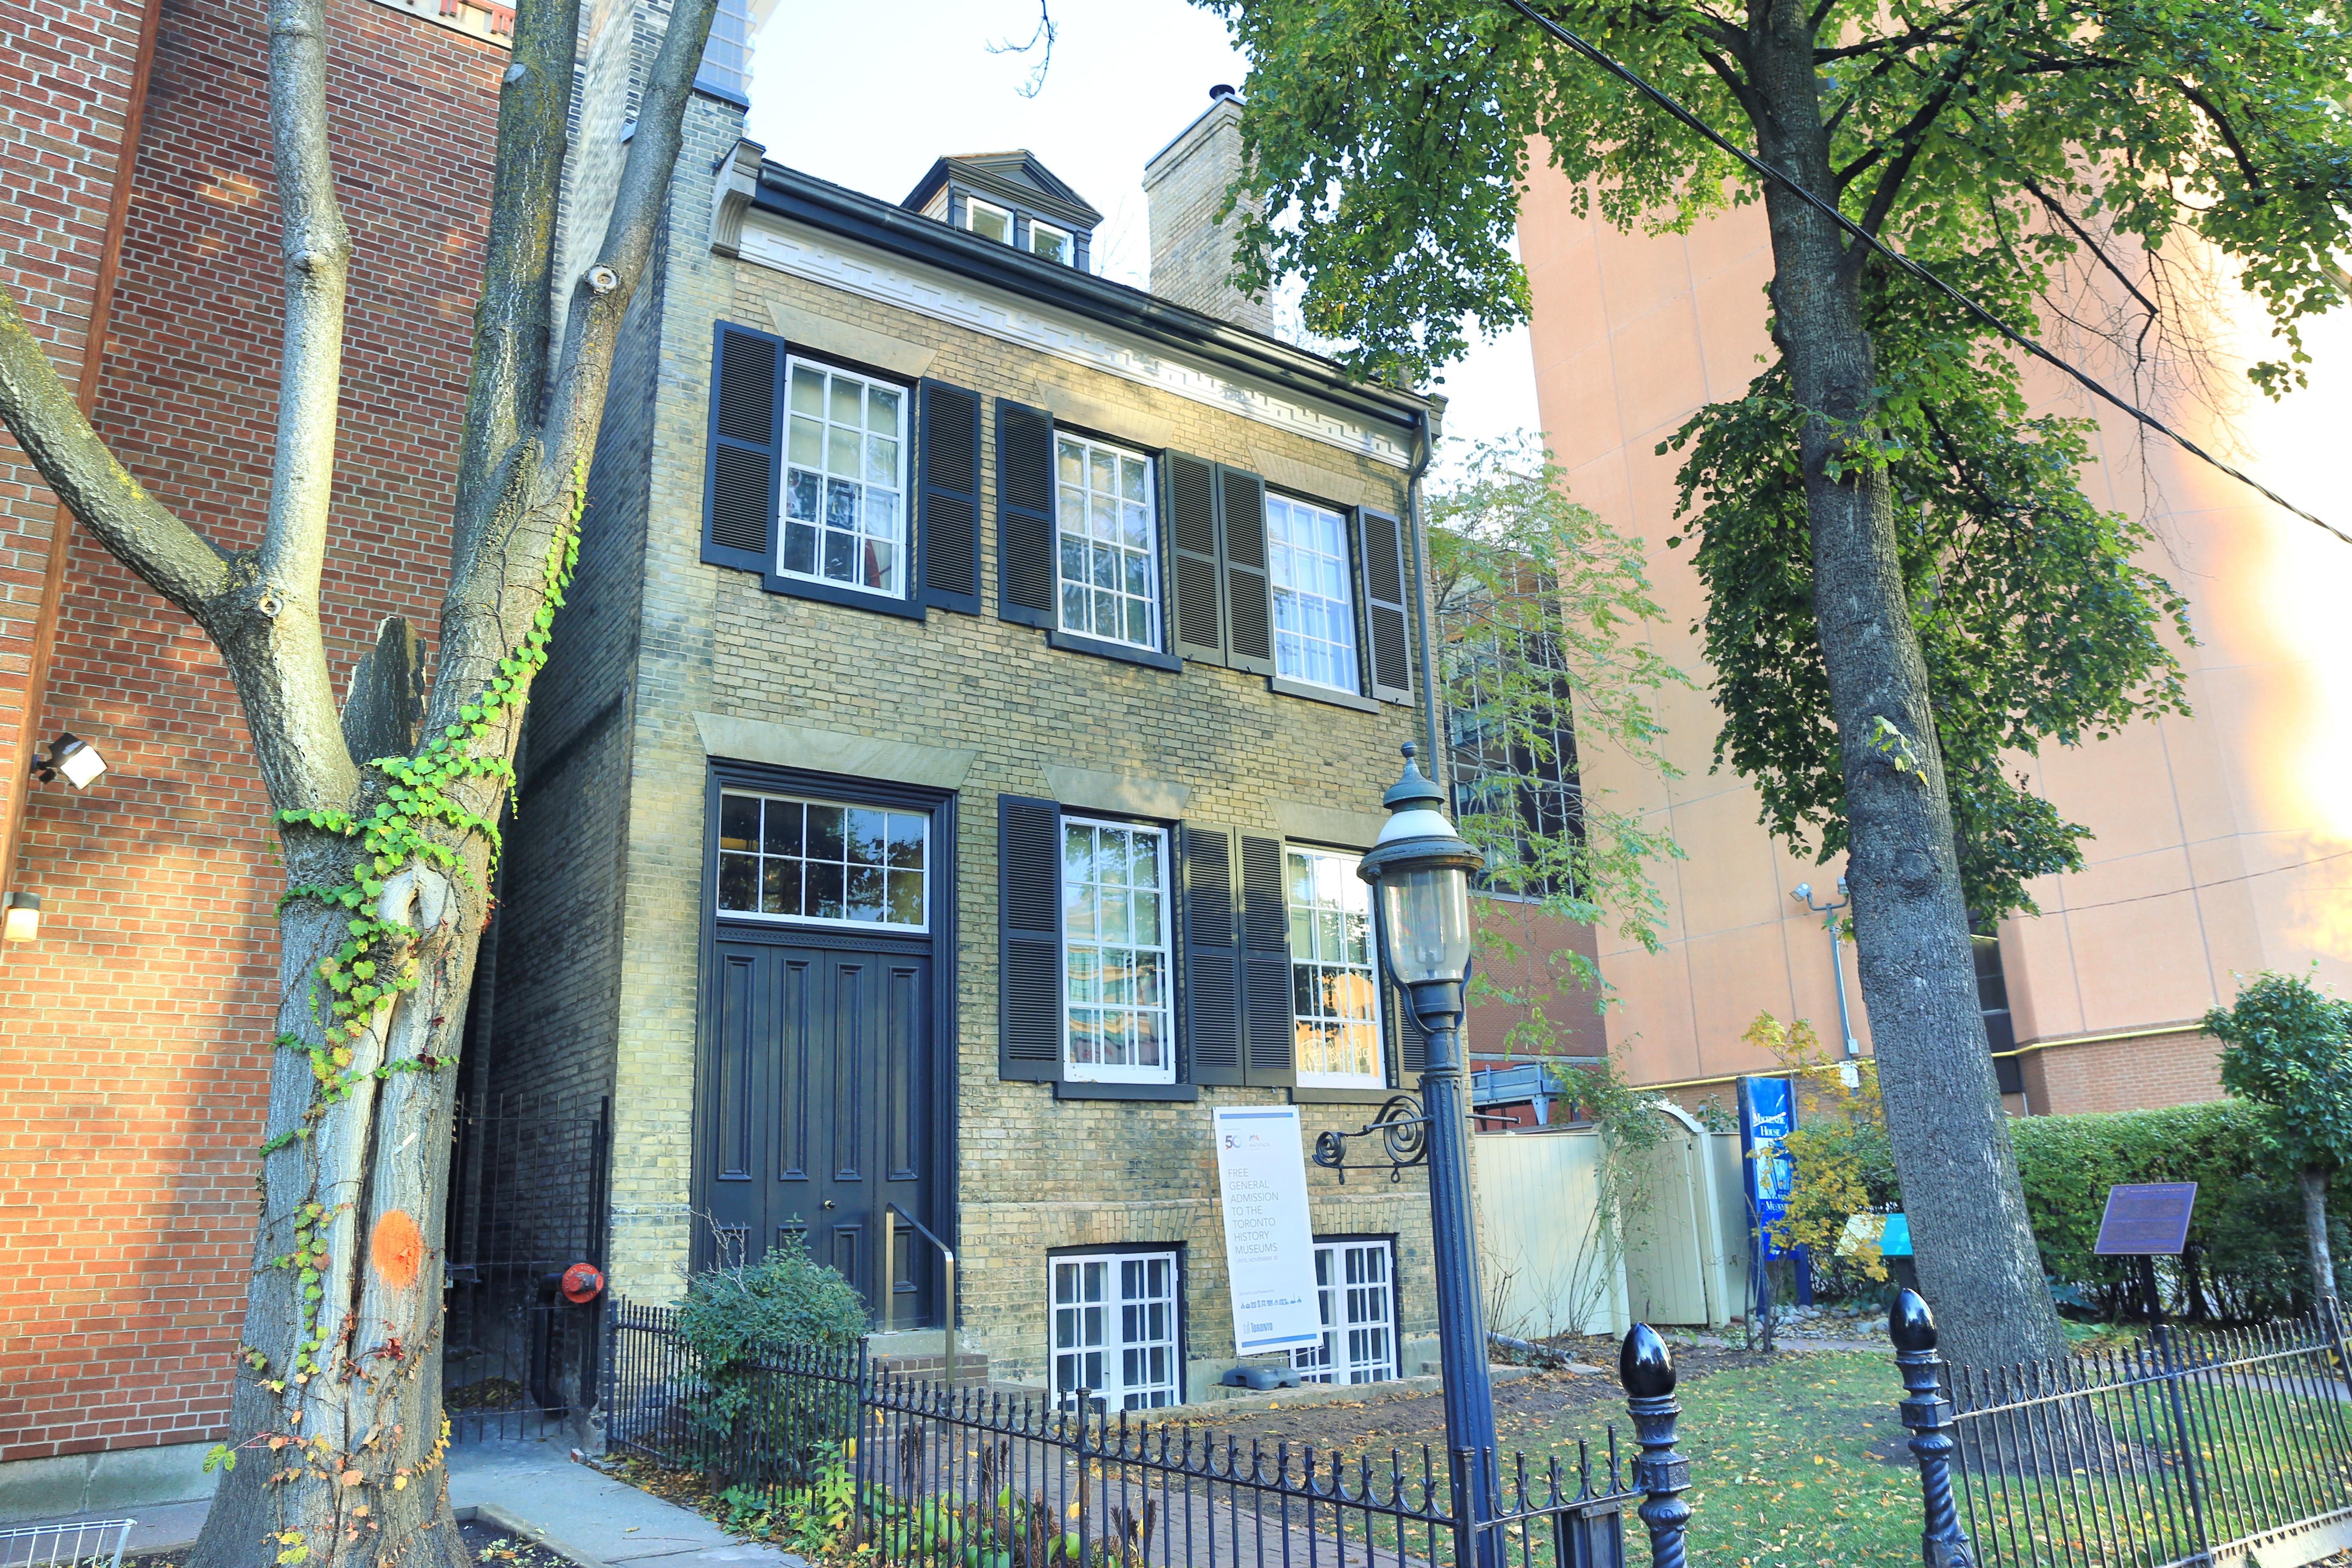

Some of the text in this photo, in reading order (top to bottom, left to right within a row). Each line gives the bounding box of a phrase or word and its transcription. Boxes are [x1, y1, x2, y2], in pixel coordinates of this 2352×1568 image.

[1761, 1125, 1781, 1136] HOUSE
[1228, 1168, 1249, 1177] FREE
[1229, 1180, 1270, 1190] GENERAL
[1231, 1192, 1279, 1203] ADMISSION
[1231, 1205, 1263, 1216] TO THE
[1232, 1217, 1276, 1228] TORONTO
[1234, 1231, 1269, 1242] HISTORY
[1235, 1243, 1277, 1254] MUSEUMS
[1250, 1322, 1273, 1333] TORONTO
